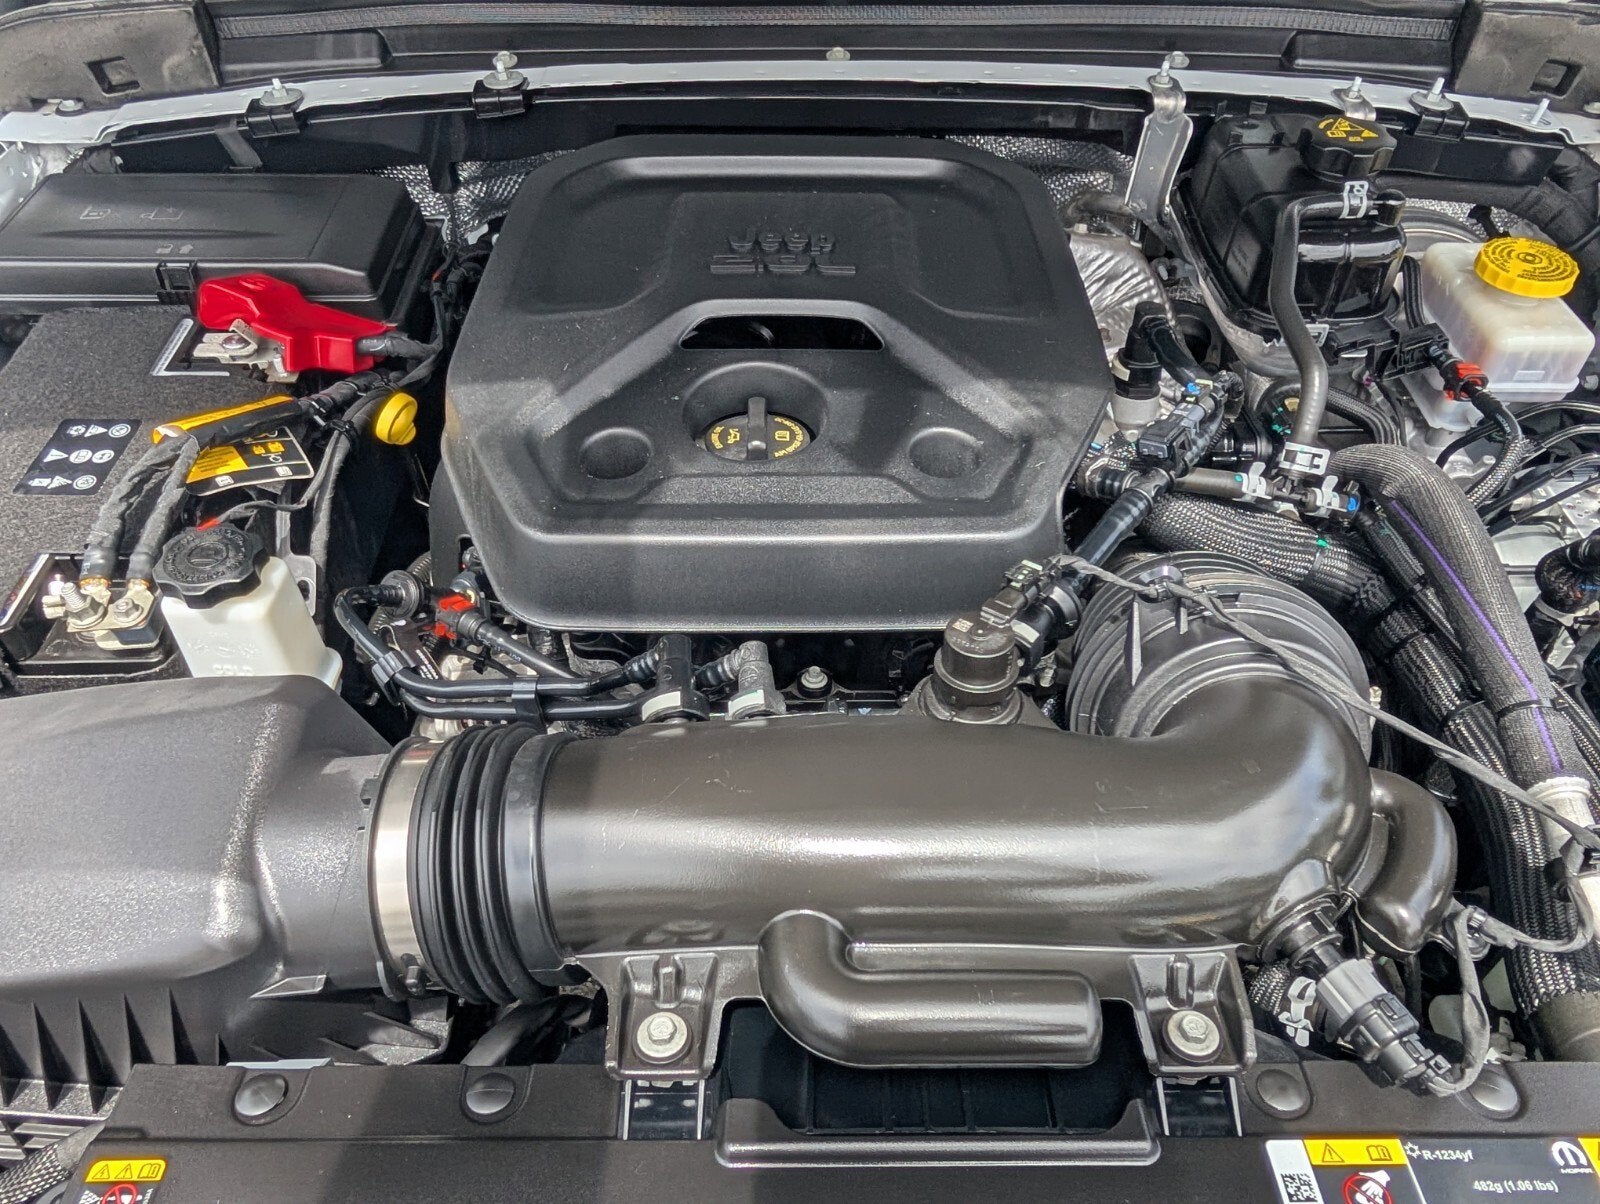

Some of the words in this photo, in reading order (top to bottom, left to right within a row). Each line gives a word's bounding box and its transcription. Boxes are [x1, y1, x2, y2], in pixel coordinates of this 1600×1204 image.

[728, 226, 836, 255] Jeep
[1421, 1149, 1474, 1162] R-1234yf
[1473, 1180, 1504, 1194] 482g
[1503, 1180, 1533, 1193] (1.06
[1533, 1180, 1559, 1193] lbs)
